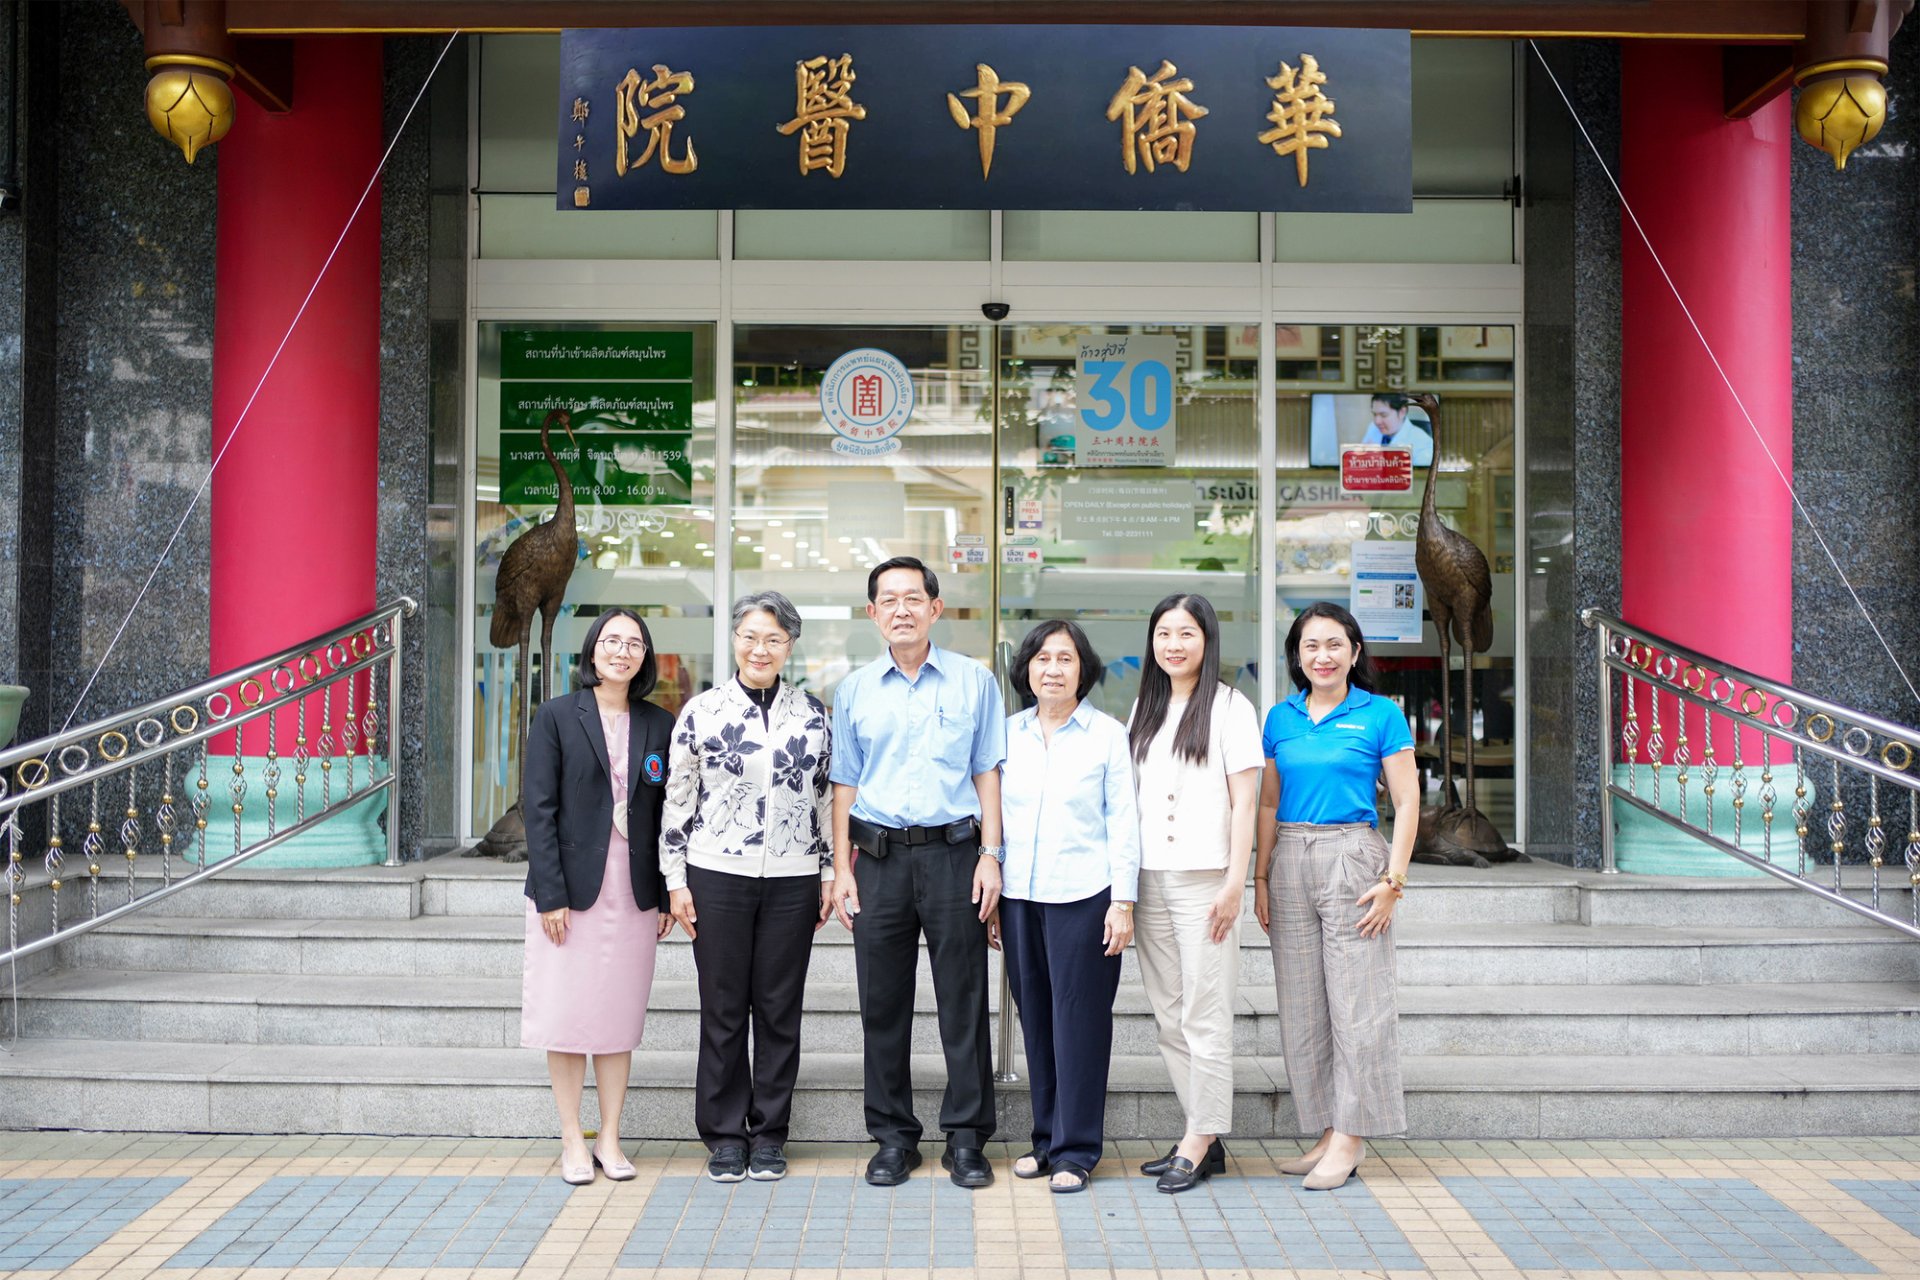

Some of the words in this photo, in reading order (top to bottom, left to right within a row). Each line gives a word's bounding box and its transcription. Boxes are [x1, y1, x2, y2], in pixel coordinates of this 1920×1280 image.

[525, 344, 666, 363] สถานที่นำเข้าผลิตภัณฑ์สมุนไพร
[1081, 360, 1171, 431] 30
[595, 485, 616, 496] 8.00
[627, 485, 654, 496] 16.00
